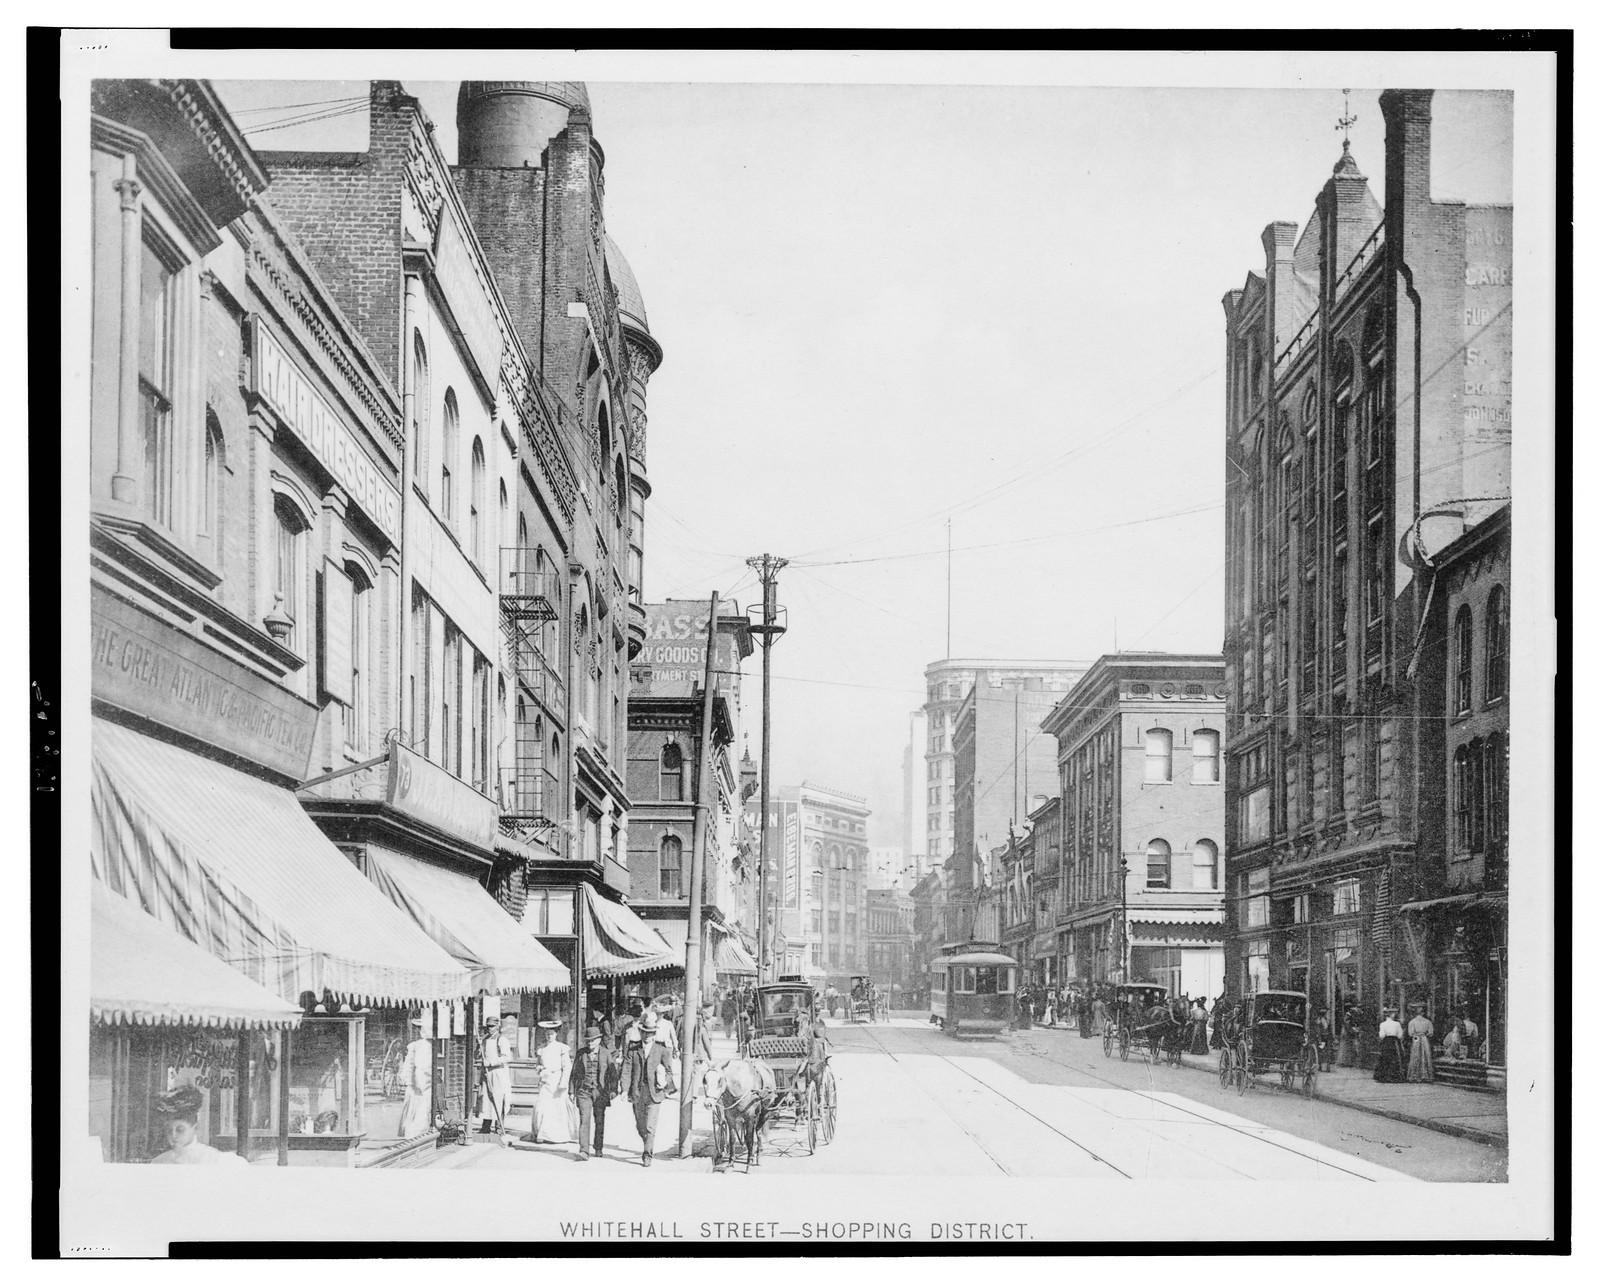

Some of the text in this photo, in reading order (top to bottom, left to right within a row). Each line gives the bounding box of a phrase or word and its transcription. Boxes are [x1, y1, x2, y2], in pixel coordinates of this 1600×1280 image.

[656, 646, 699, 664] GOODS
[121, 640, 168, 689] GREAT
[238, 696, 276, 739] PACIFIC
